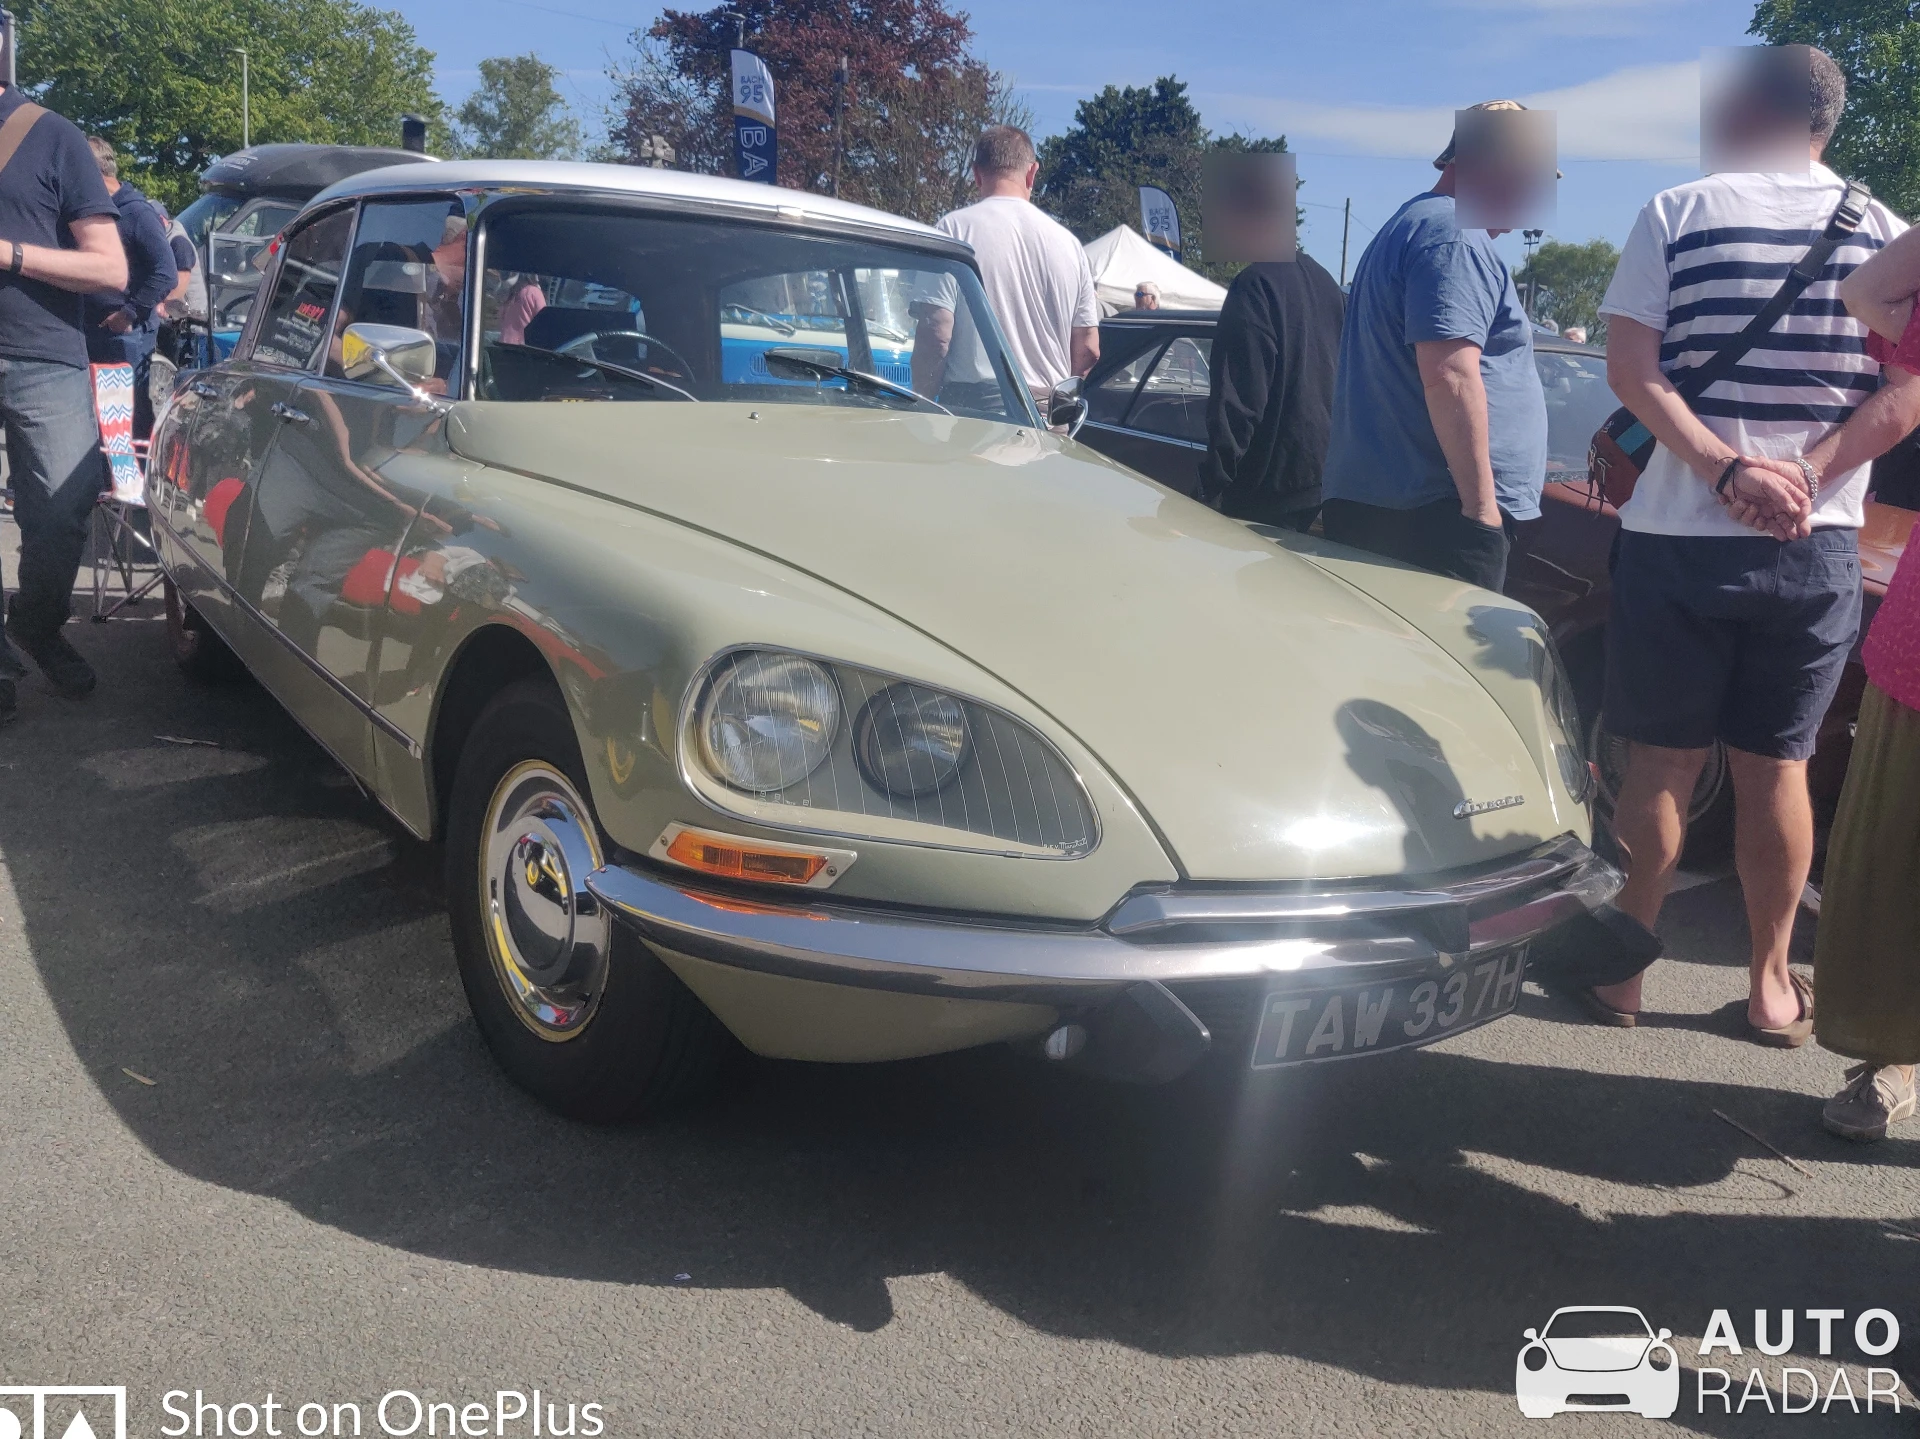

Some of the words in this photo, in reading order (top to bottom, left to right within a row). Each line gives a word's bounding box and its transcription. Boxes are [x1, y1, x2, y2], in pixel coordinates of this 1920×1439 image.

[740, 75, 766, 84] BACH
[740, 85, 764, 103] 95
[740, 126, 769, 184] BA
[1149, 216, 1170, 233] 95
[1271, 987, 1394, 1058] TAW
[1403, 949, 1524, 1037] 337H
